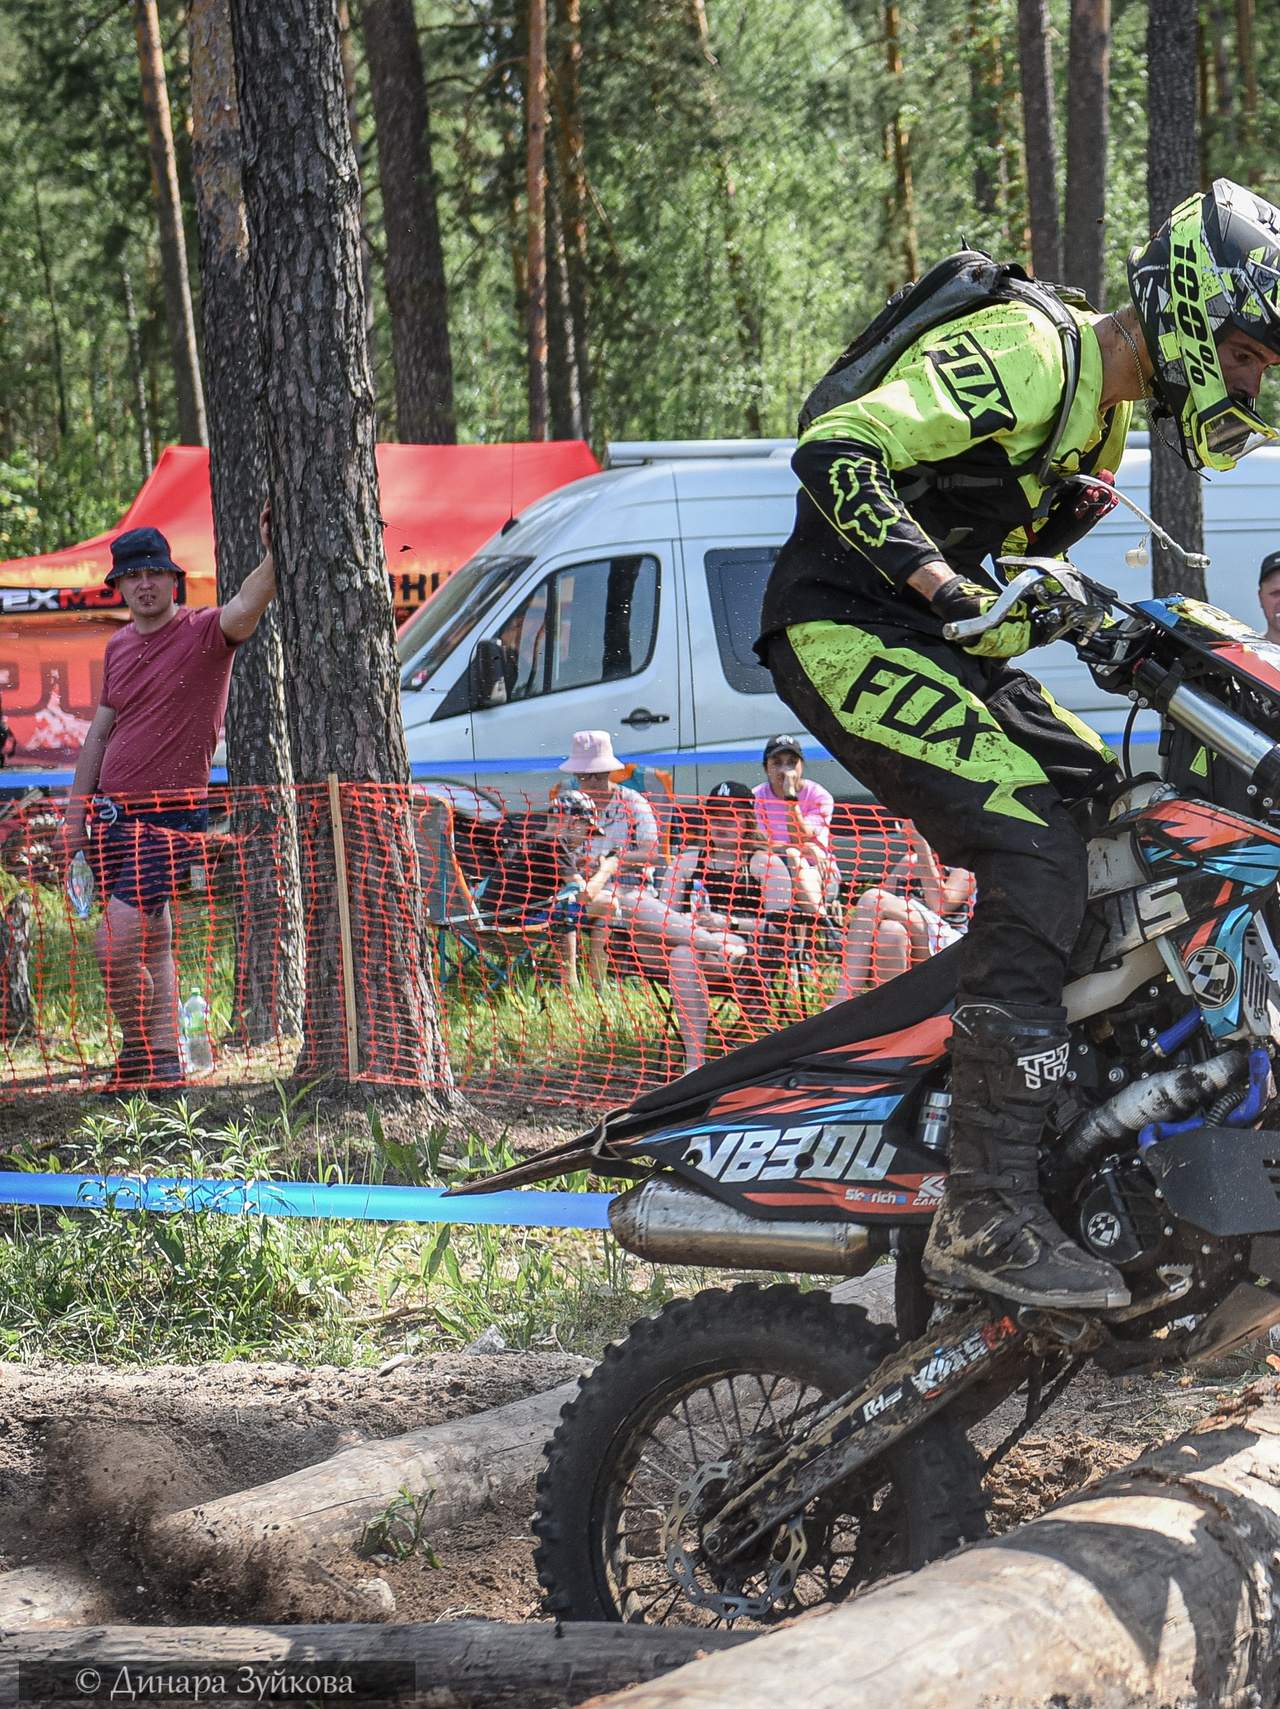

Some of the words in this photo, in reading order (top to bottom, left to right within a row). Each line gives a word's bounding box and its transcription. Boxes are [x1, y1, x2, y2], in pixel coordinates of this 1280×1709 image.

[1172, 239, 1220, 387] 100%
[924, 333, 1014, 420] FOX
[839, 654, 1004, 762] FOX
